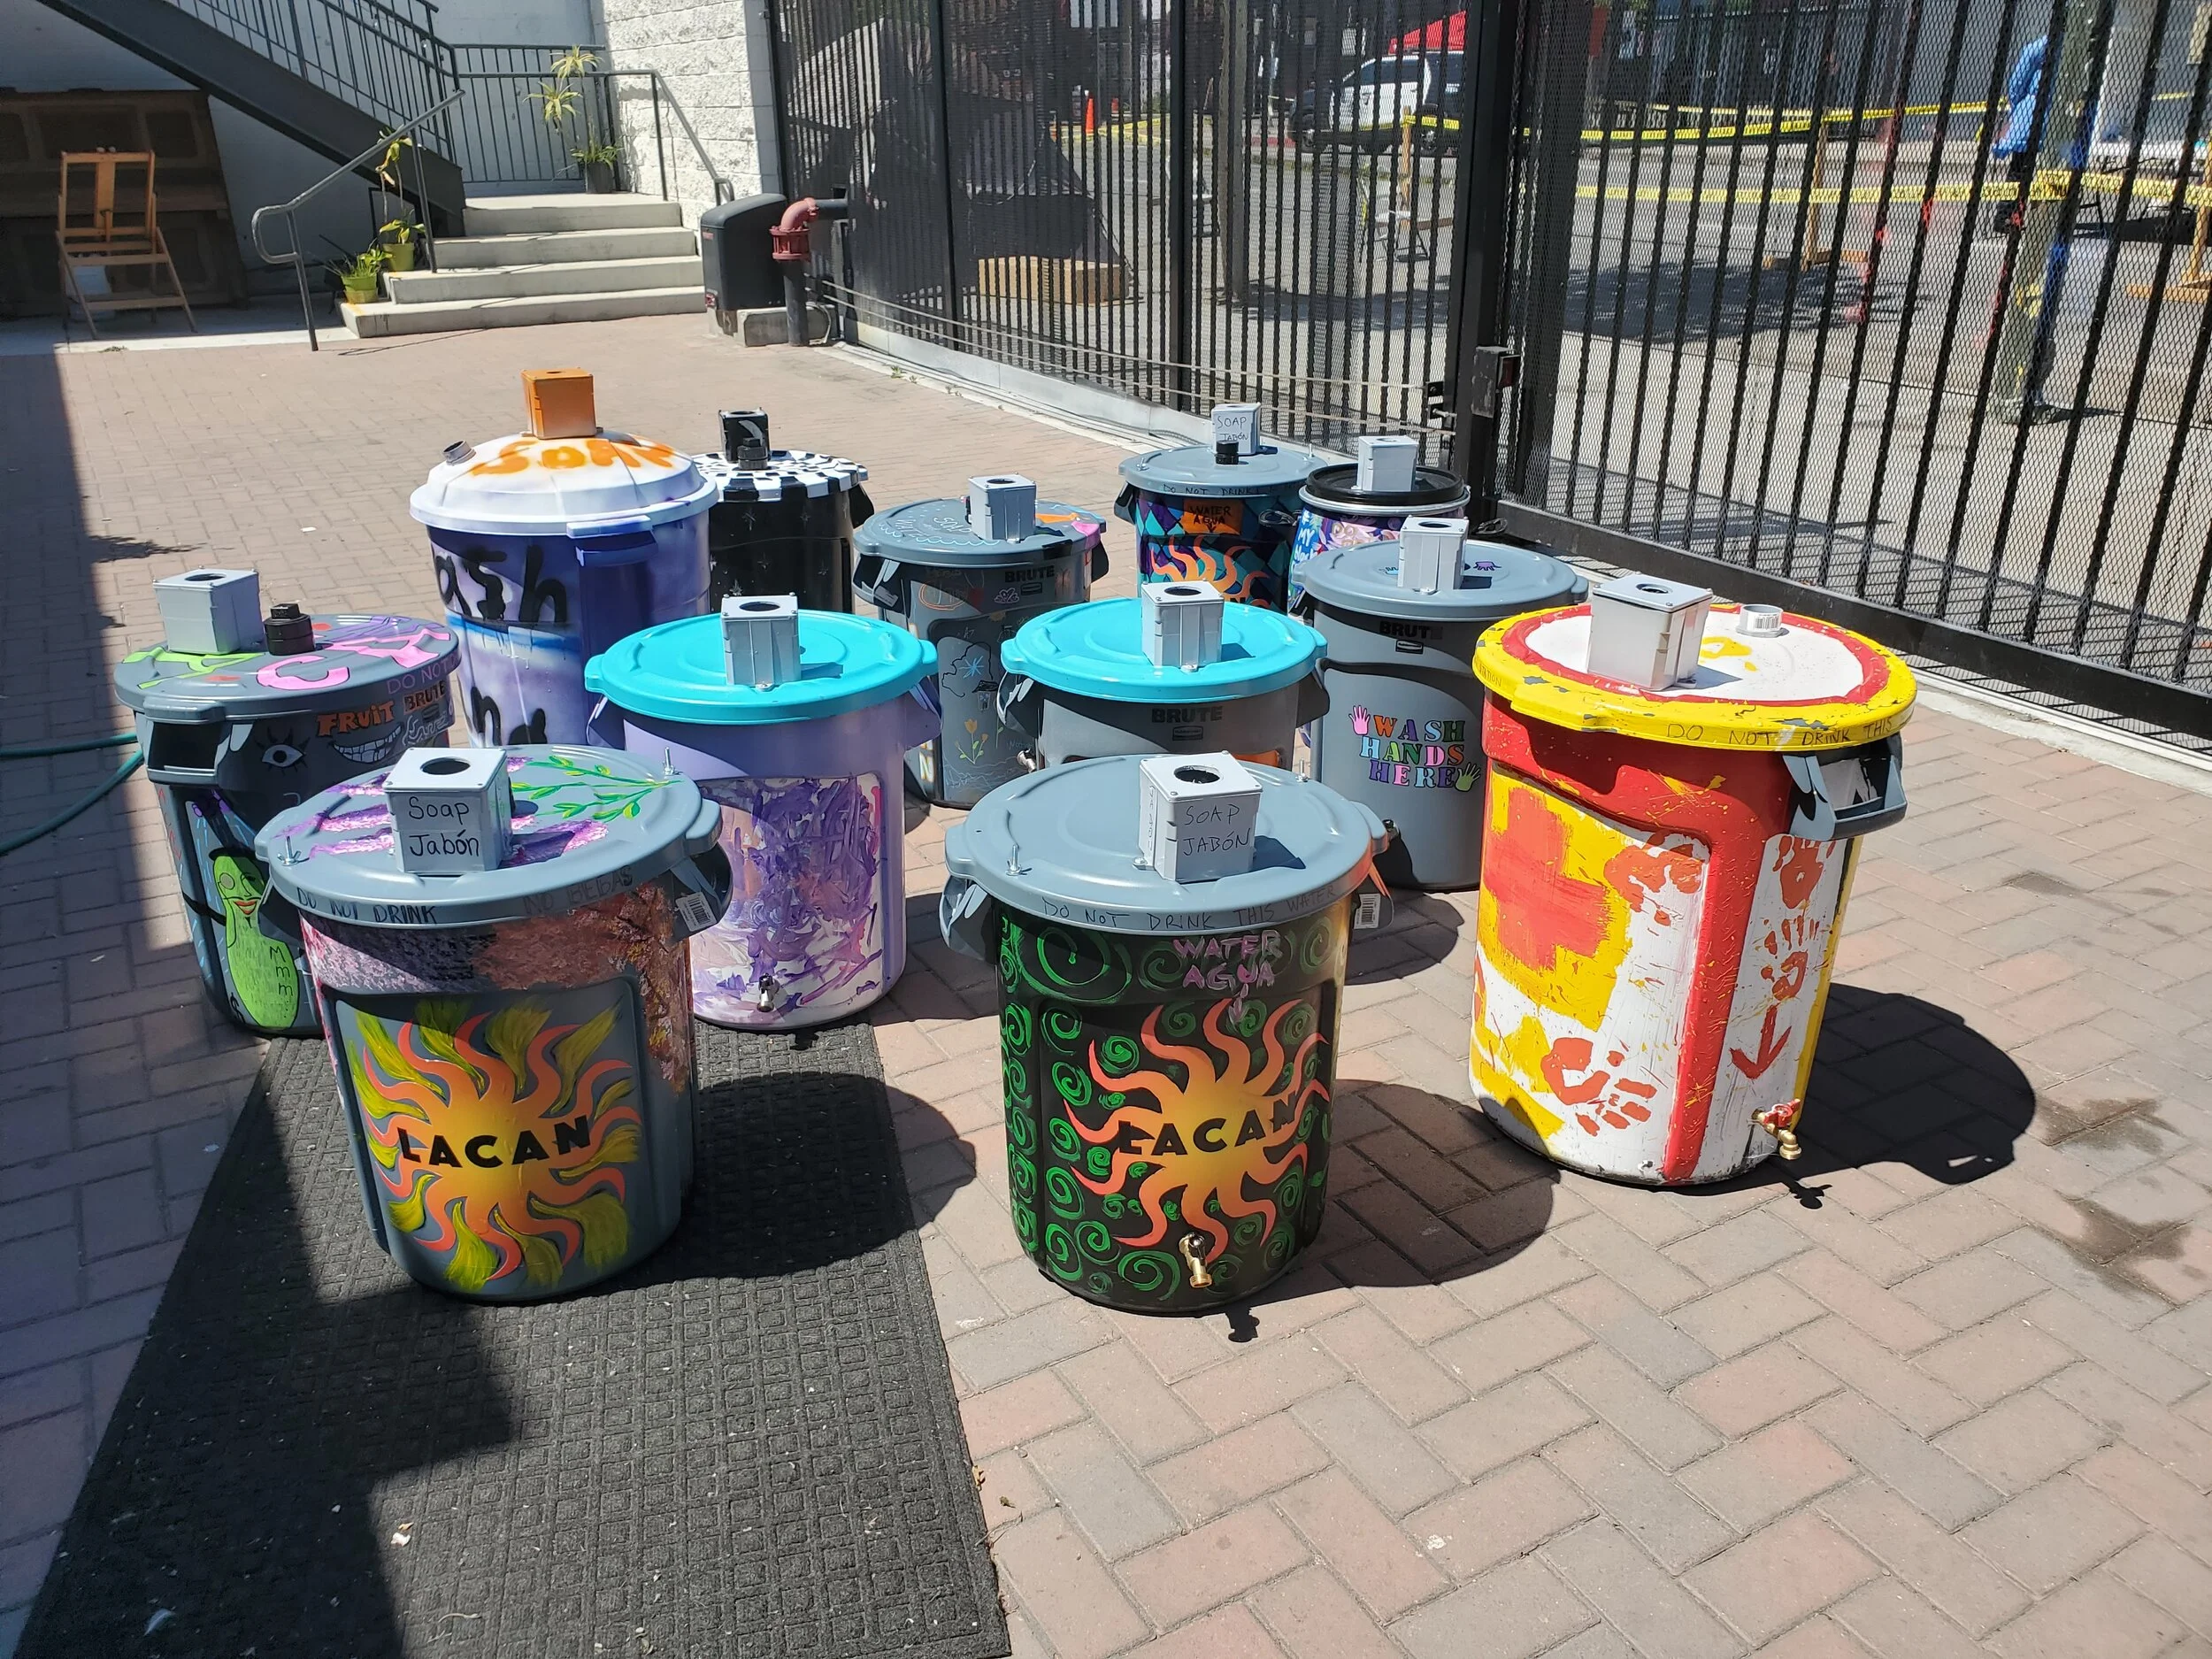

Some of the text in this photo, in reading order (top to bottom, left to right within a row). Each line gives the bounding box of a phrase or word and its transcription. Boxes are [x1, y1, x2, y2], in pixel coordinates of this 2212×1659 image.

[1217, 416, 1247, 429] SOAP
[434, 544, 568, 624] ash
[1005, 565, 1056, 583] BRUTE
[387, 673, 416, 695] DO
[421, 660, 449, 684] NOT
[403, 680, 447, 711] BRUTE
[1151, 706, 1223, 723] BRUTE
[1373, 715, 1466, 742] WASH
[1667, 716, 1893, 746] DO NOT DRINK THIS
[1359, 735, 1465, 767] HANDS
[1369, 759, 1456, 788] HERE
[408, 795, 471, 826] Soap
[1184, 803, 1240, 826] SOAP
[408, 828, 480, 857] Jabón
[1182, 827, 1251, 856] JABÓN
[373, 904, 438, 925] DRINK
[523, 891, 554, 915] NO
[1042, 896, 1070, 918] DO
[1085, 909, 1131, 927] NOT
[1147, 912, 1217, 931] DRINK
[1233, 902, 1275, 927] THIS
[1285, 885, 1336, 913] WATER
[1172, 929, 1284, 960] WATER
[1182, 959, 1275, 992] AGUA
[396, 1115, 591, 1169] LACAN
